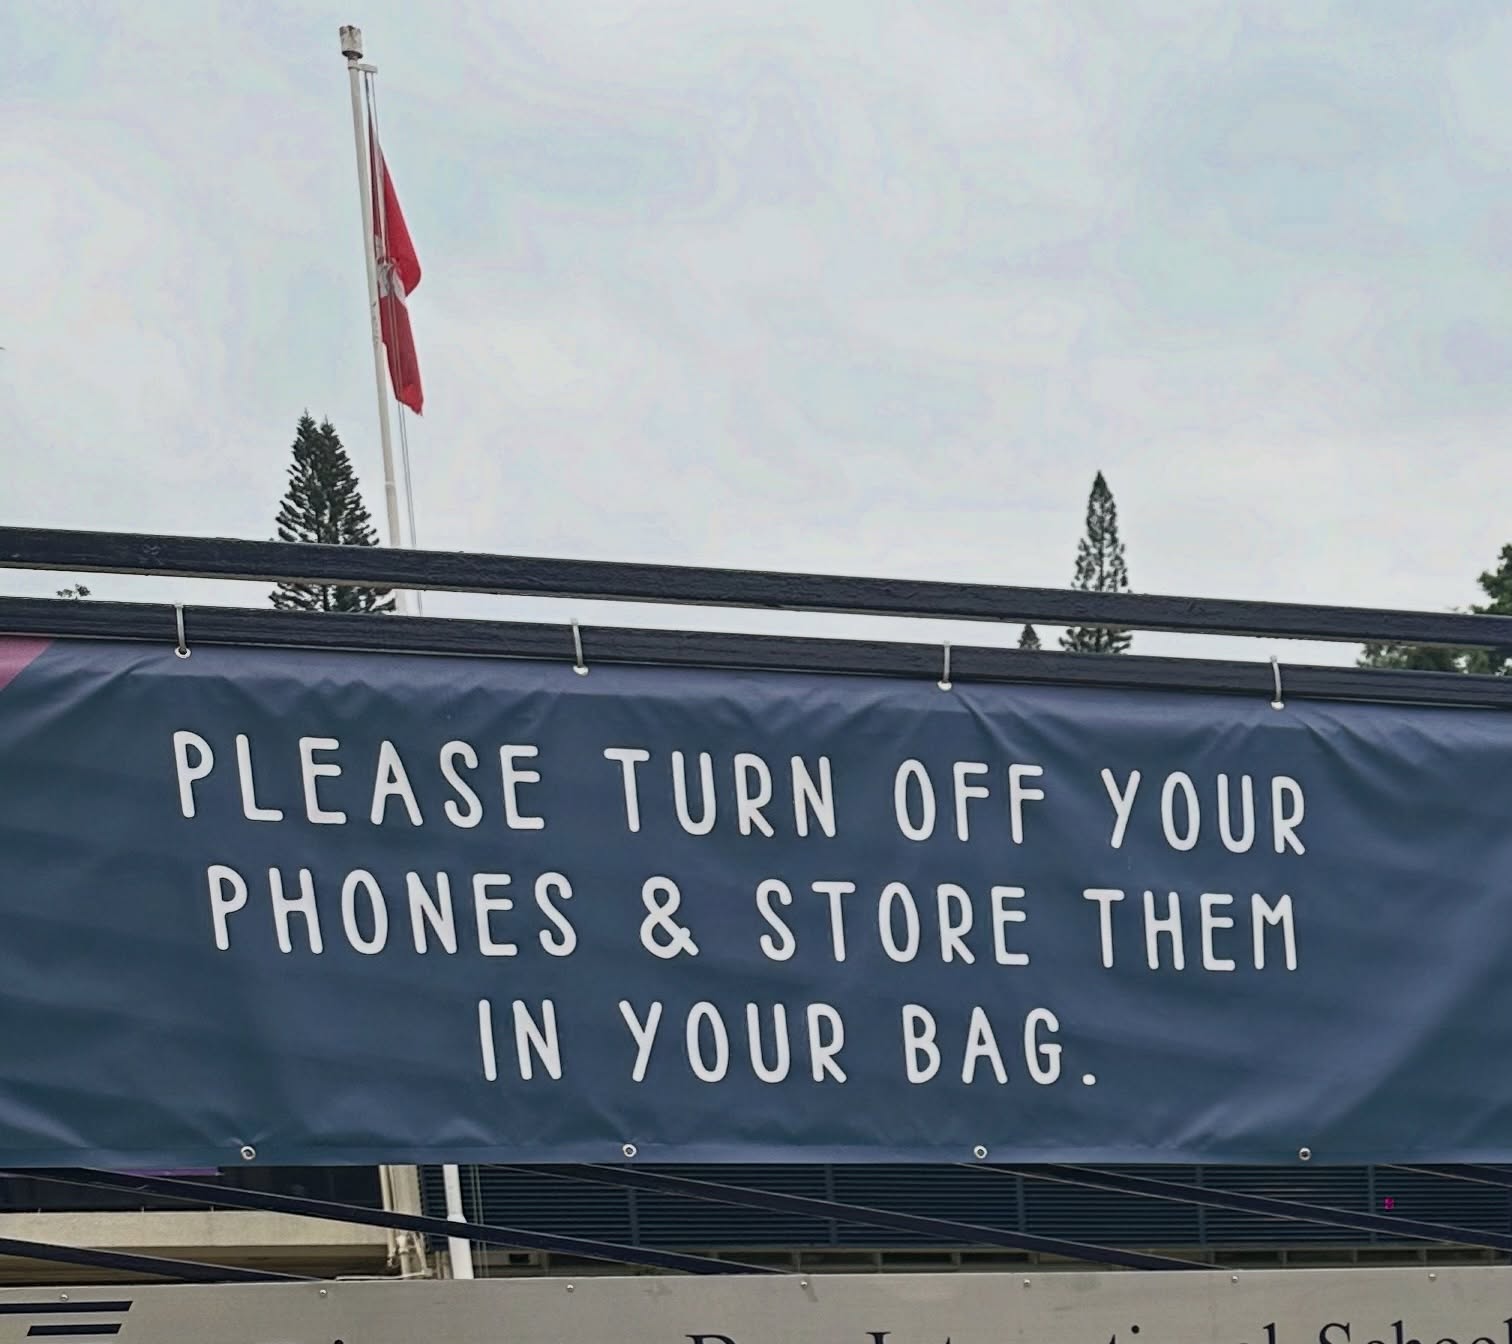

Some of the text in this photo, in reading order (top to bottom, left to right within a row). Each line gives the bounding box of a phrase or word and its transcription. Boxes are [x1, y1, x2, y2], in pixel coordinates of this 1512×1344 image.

[173, 730, 1306, 856] PLEASE TURN OFF YOUR
[207, 864, 1297, 971] PHONES & STORE THEM
[478, 999, 1096, 1086] IN YOUR BAG.
